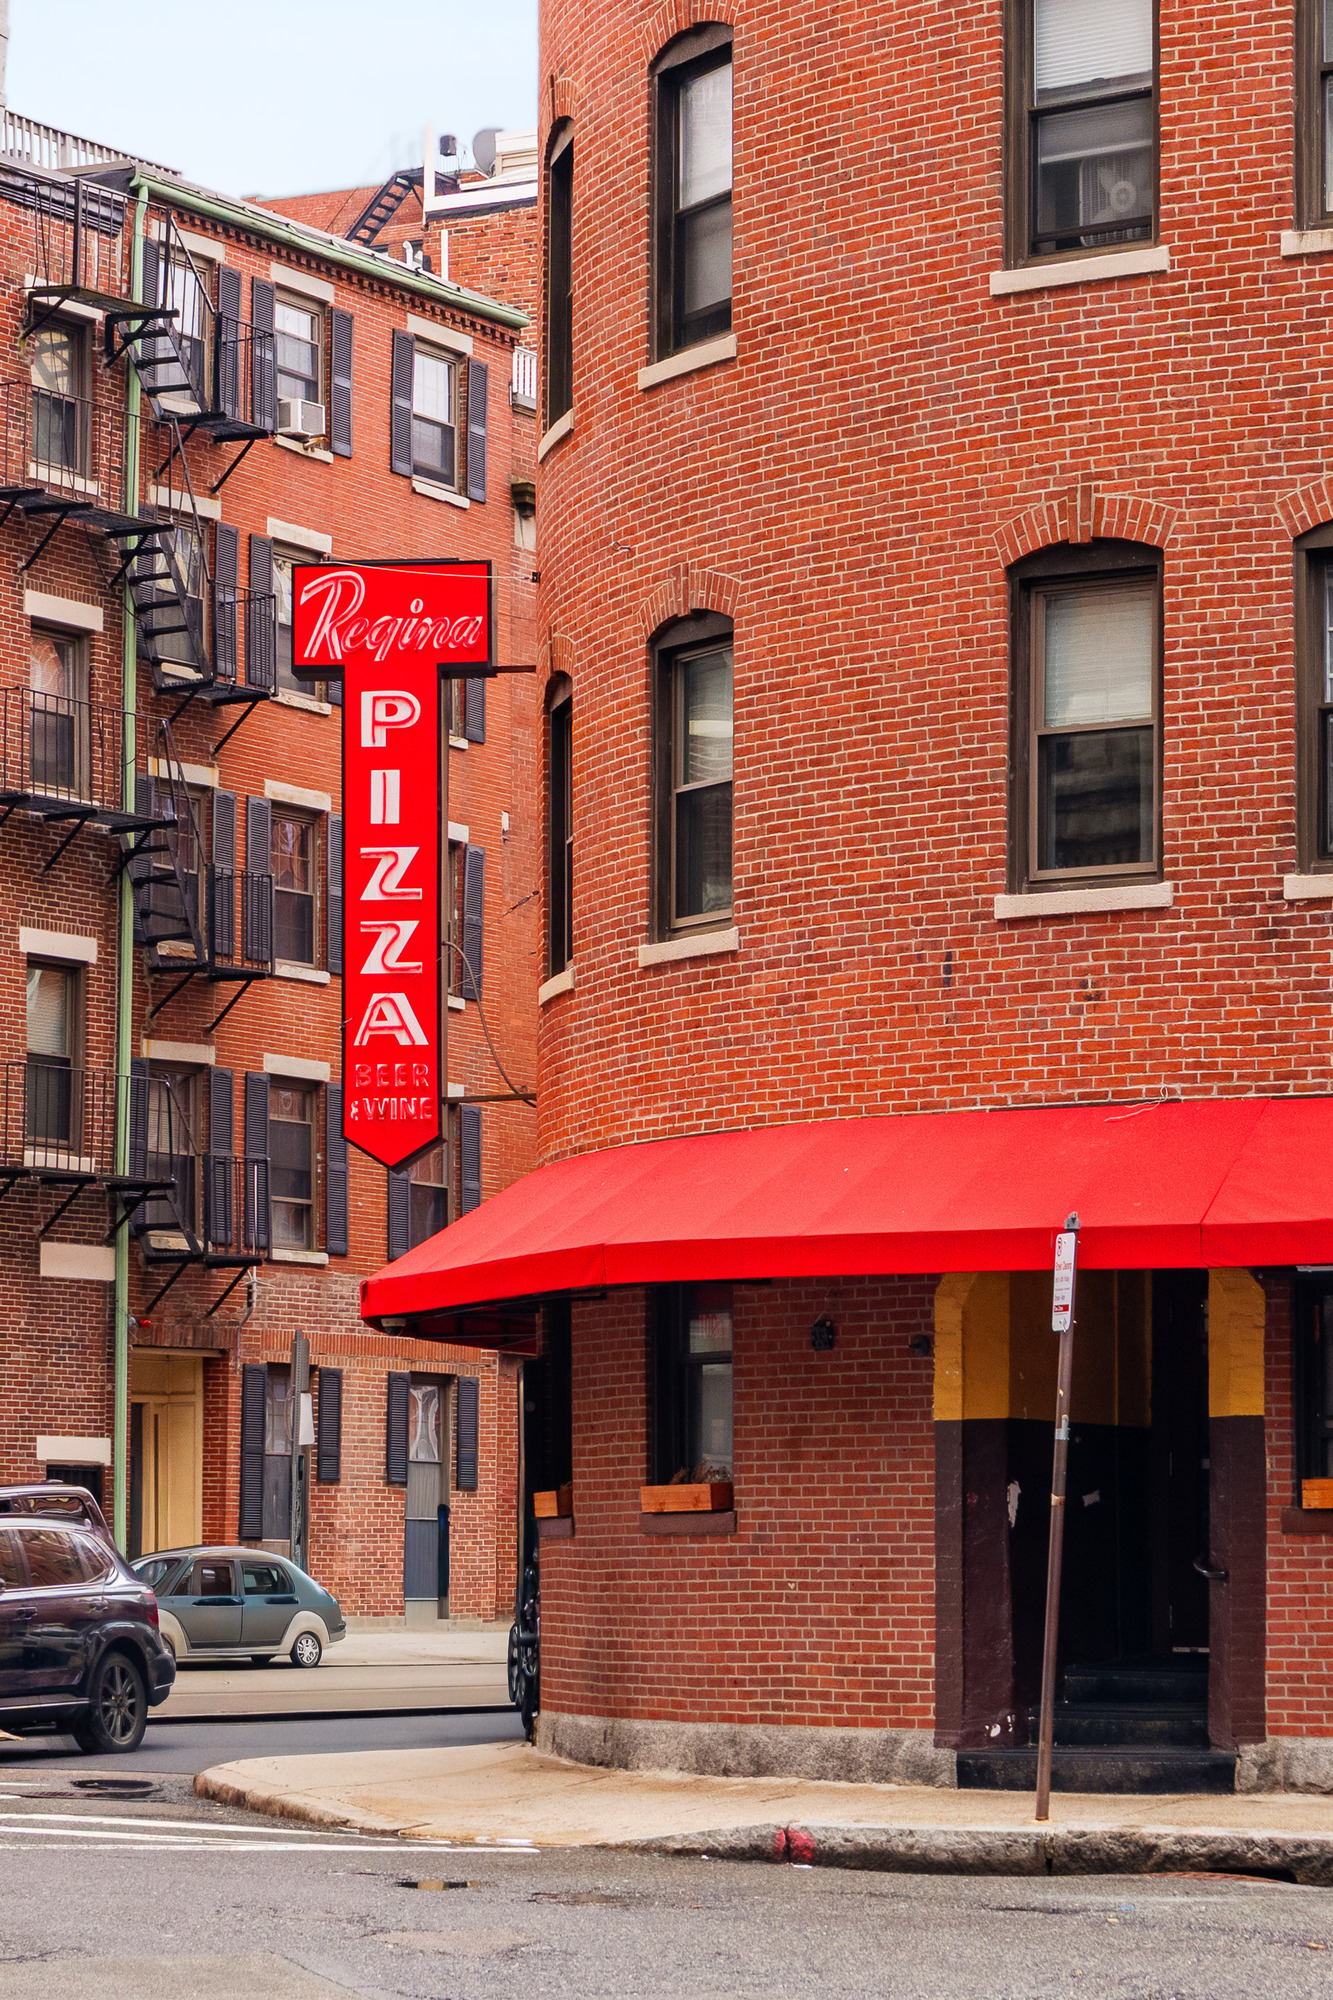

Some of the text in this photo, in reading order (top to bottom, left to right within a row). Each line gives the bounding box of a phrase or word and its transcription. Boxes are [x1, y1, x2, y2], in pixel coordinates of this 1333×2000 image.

[300, 570, 483, 662] Regina
[353, 690, 429, 1046] PIZZA
[355, 1063, 429, 1088] BEER
